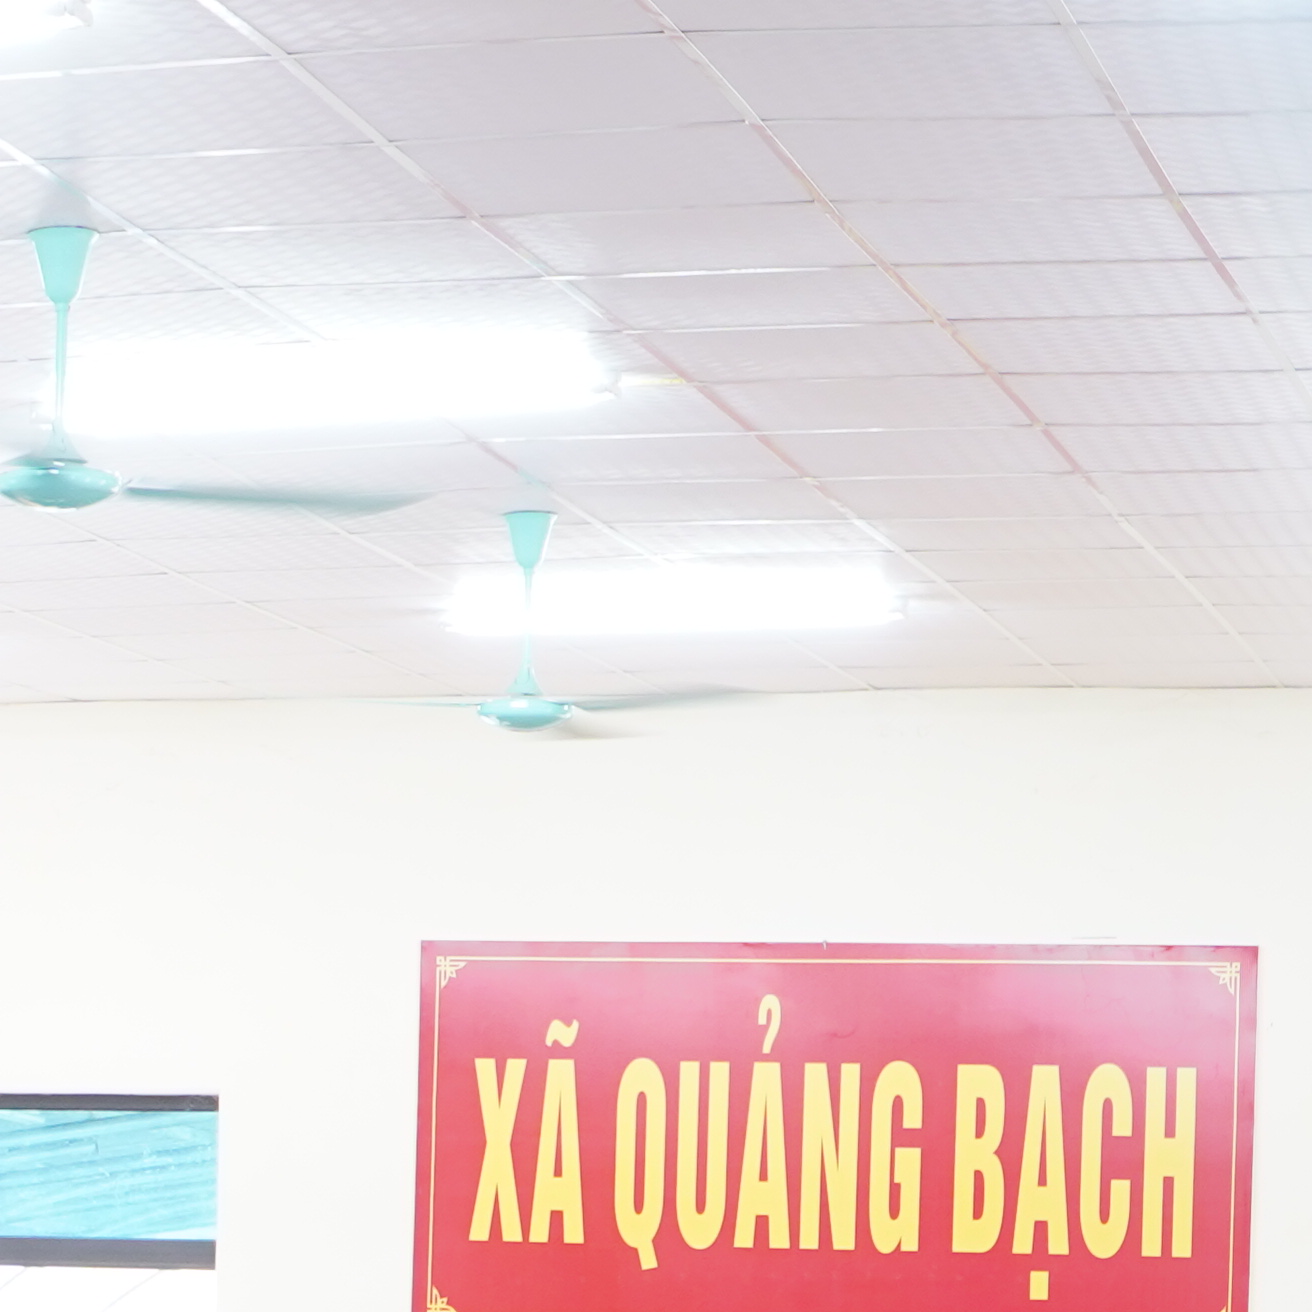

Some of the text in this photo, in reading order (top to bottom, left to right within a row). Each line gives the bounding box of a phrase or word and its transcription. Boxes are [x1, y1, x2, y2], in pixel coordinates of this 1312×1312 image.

[468, 994, 1198, 1301] XÃ QUẢNG BẠCH
